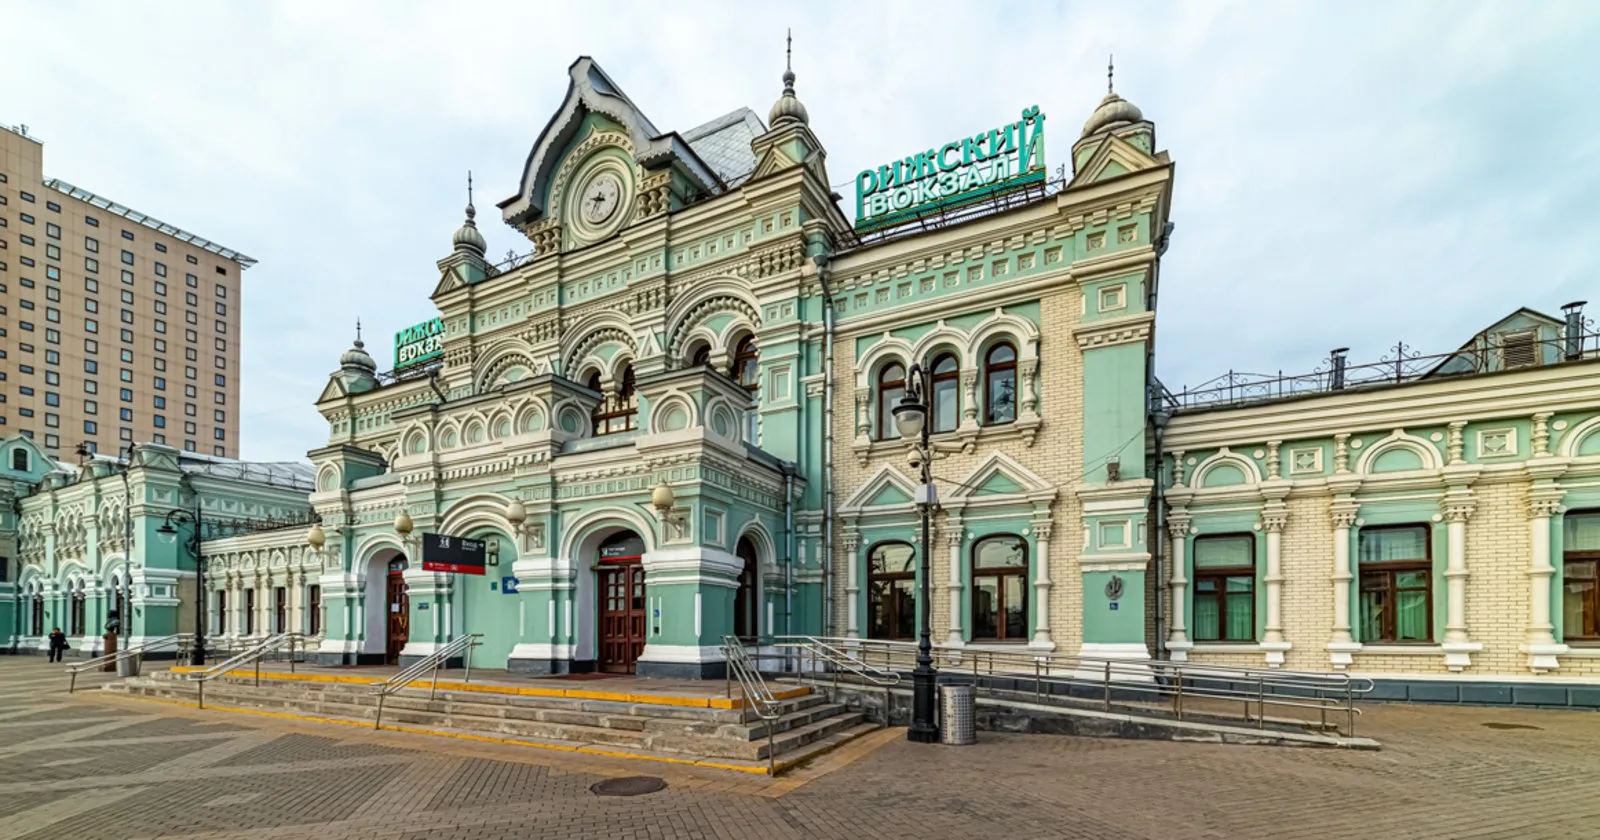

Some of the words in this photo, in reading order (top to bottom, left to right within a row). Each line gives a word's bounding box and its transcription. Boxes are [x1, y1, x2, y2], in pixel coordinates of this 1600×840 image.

[855, 104, 1046, 220] РИЖСКИЙ
[870, 156, 1011, 217] ВОКЗАЛ
[394, 316, 444, 364] РИЖСК
[400, 332, 446, 361] ВОКЗА
